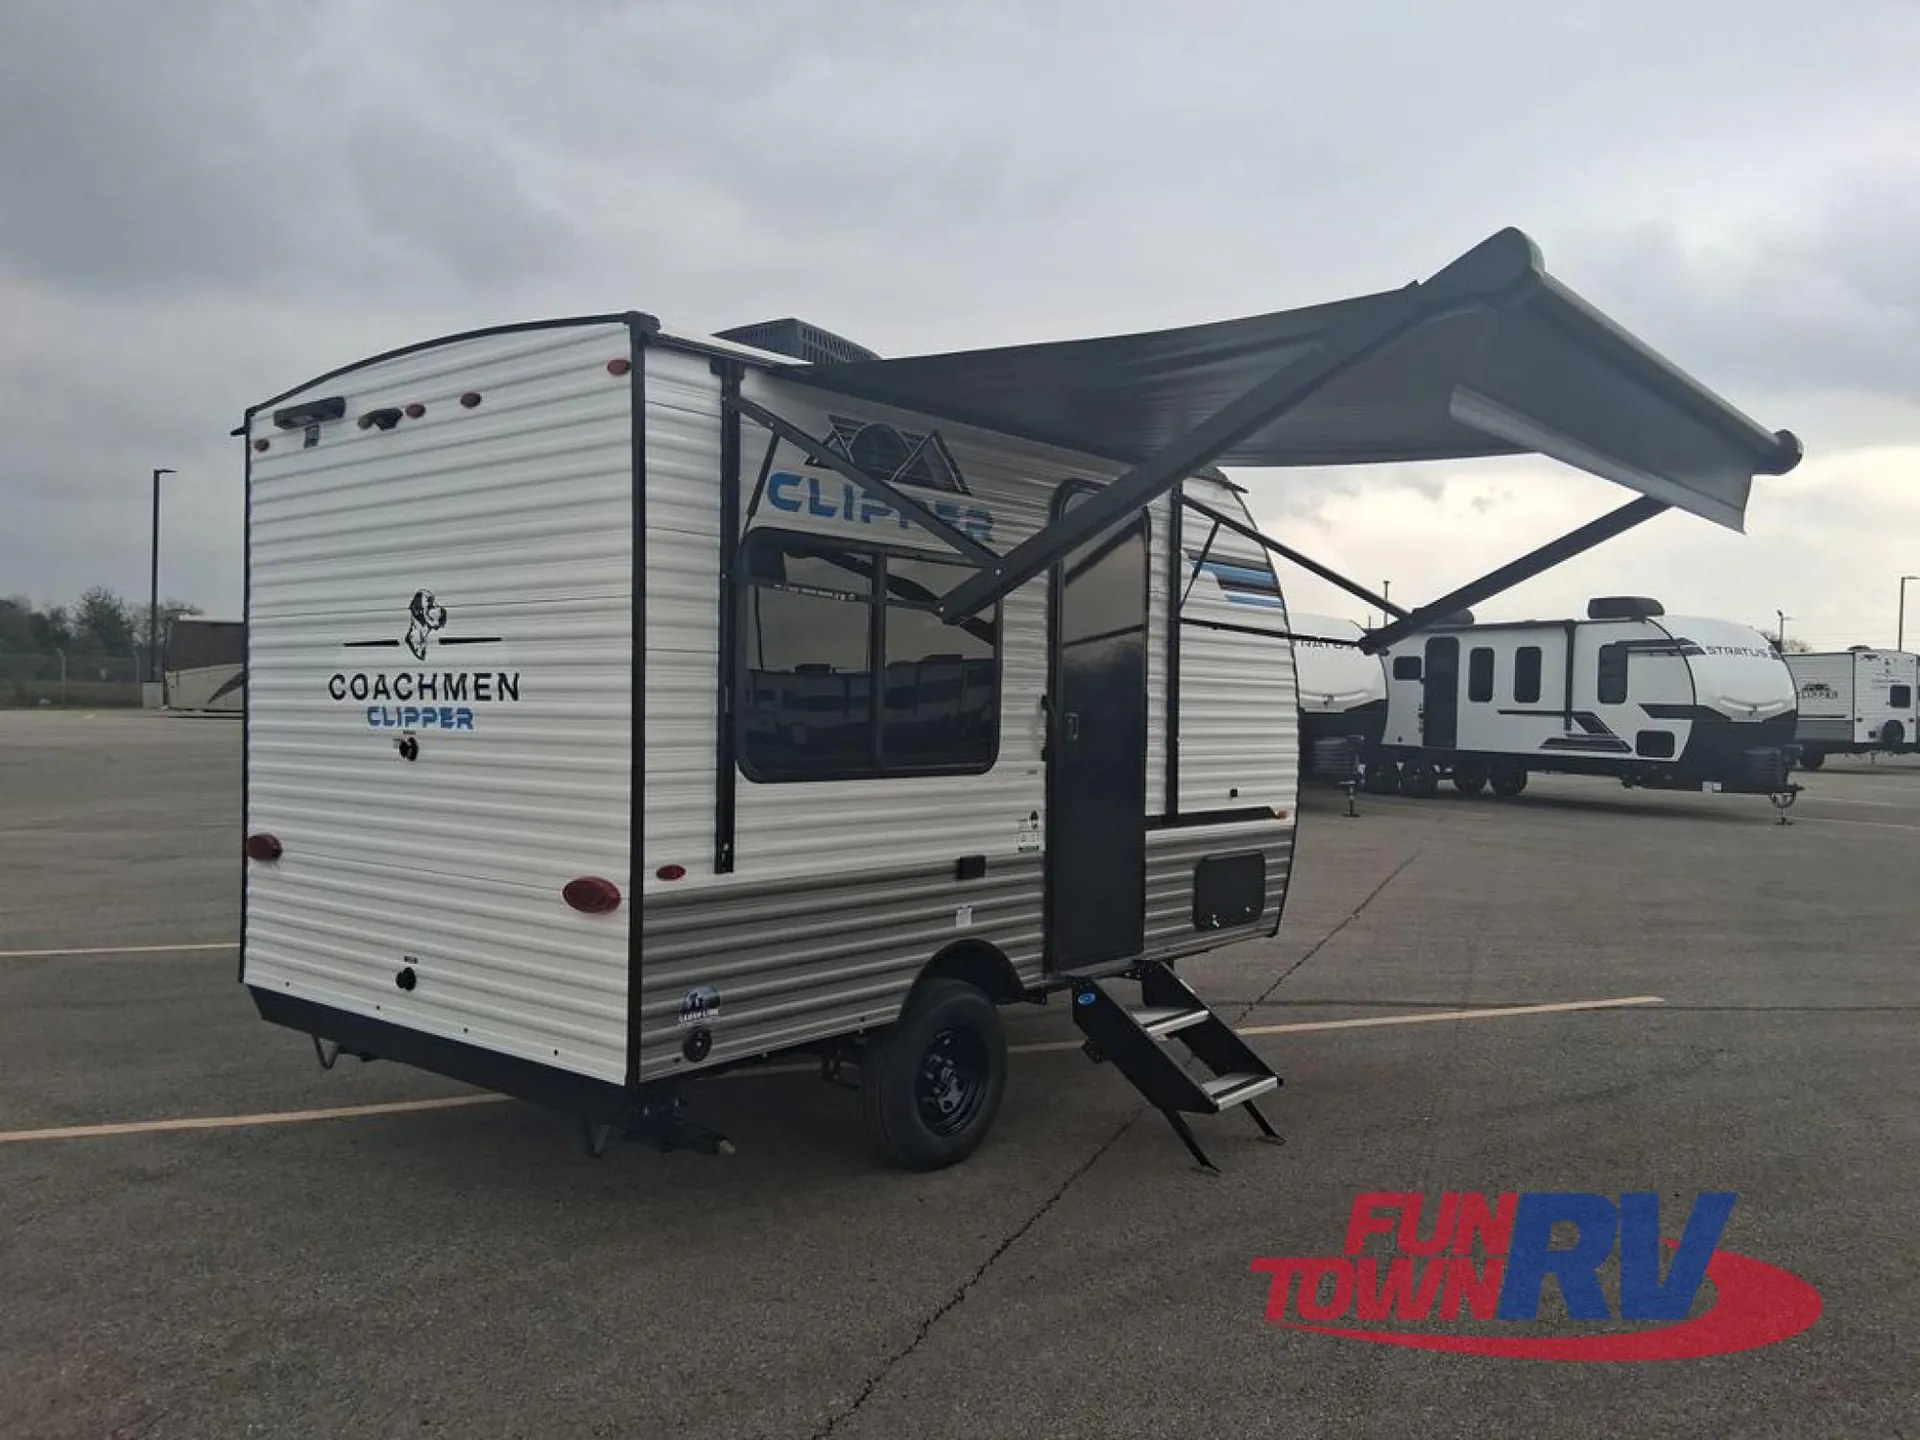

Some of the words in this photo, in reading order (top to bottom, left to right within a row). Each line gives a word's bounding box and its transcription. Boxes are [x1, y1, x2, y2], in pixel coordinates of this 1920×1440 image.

[1706, 645, 1767, 657] STRATUS
[328, 672, 520, 701] COACHMEN
[367, 706, 474, 730] CLIPPER
